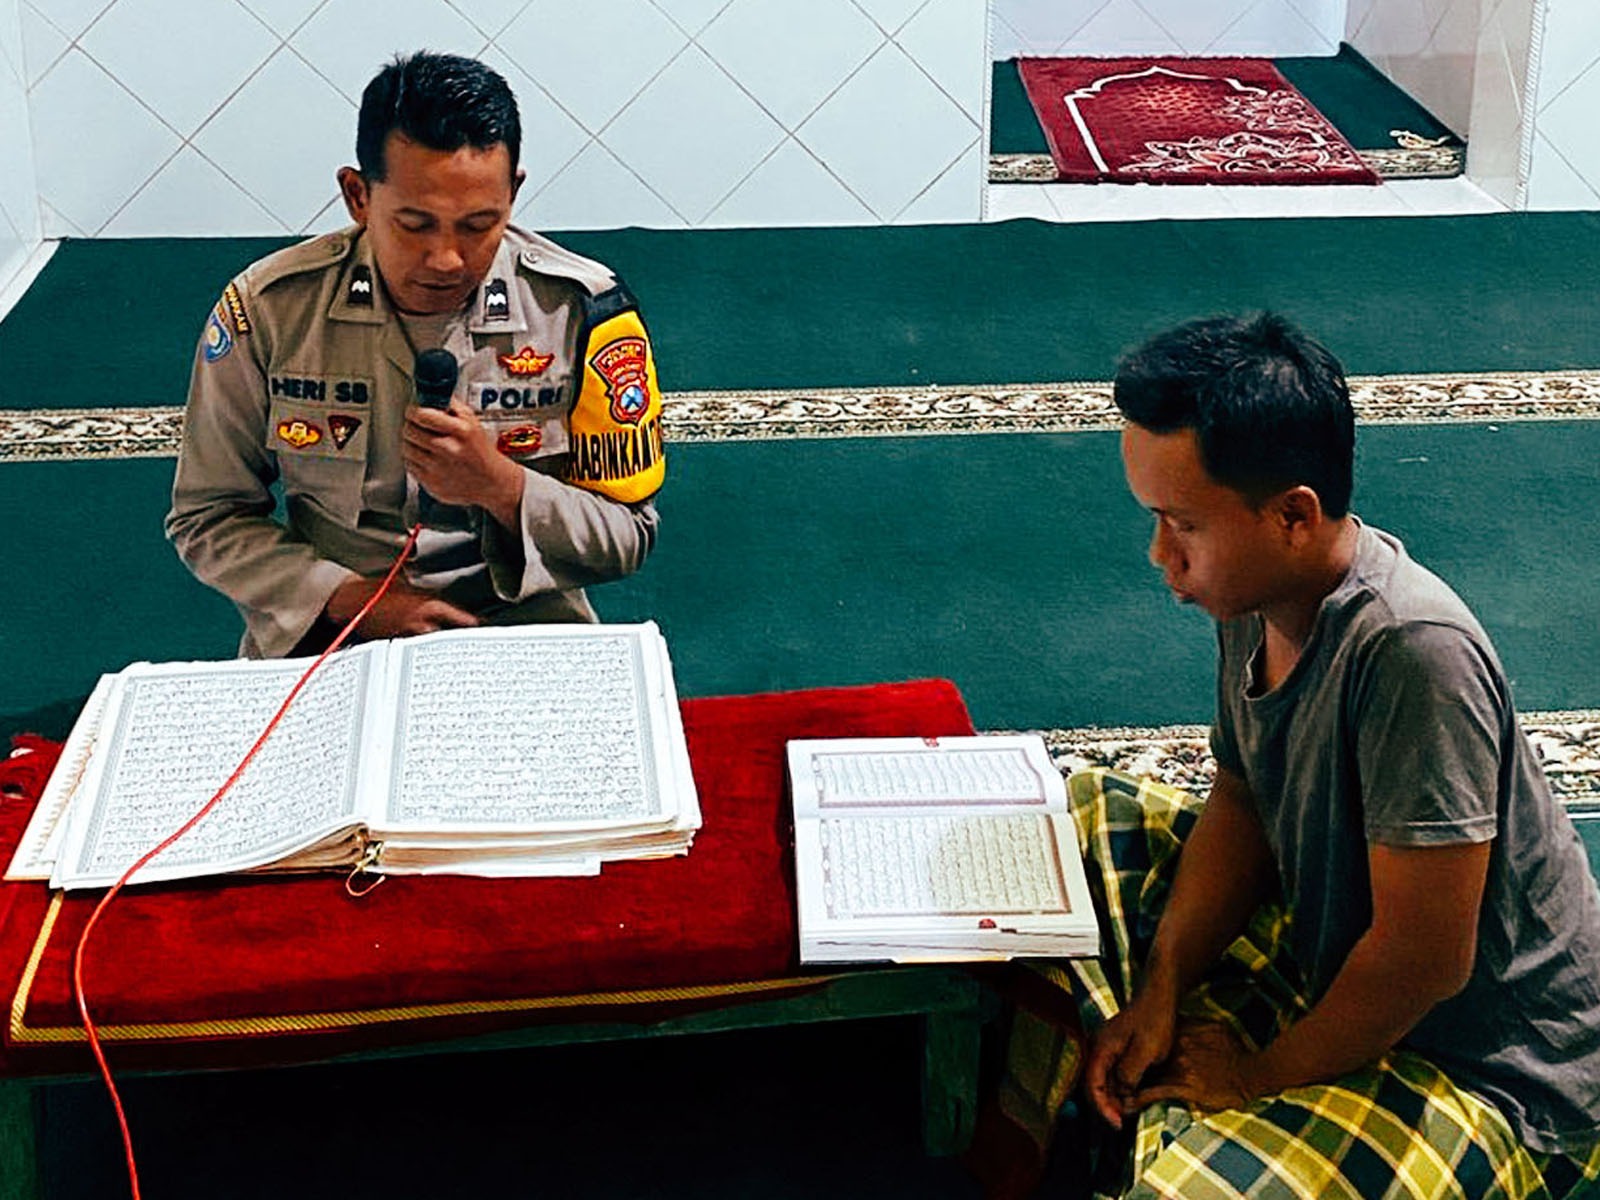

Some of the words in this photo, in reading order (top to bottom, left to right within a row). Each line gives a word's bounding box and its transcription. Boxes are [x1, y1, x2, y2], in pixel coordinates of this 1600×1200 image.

[272, 377, 327, 402] HERI
[336, 381, 368, 404] SB
[480, 385, 563, 410] POLRI
